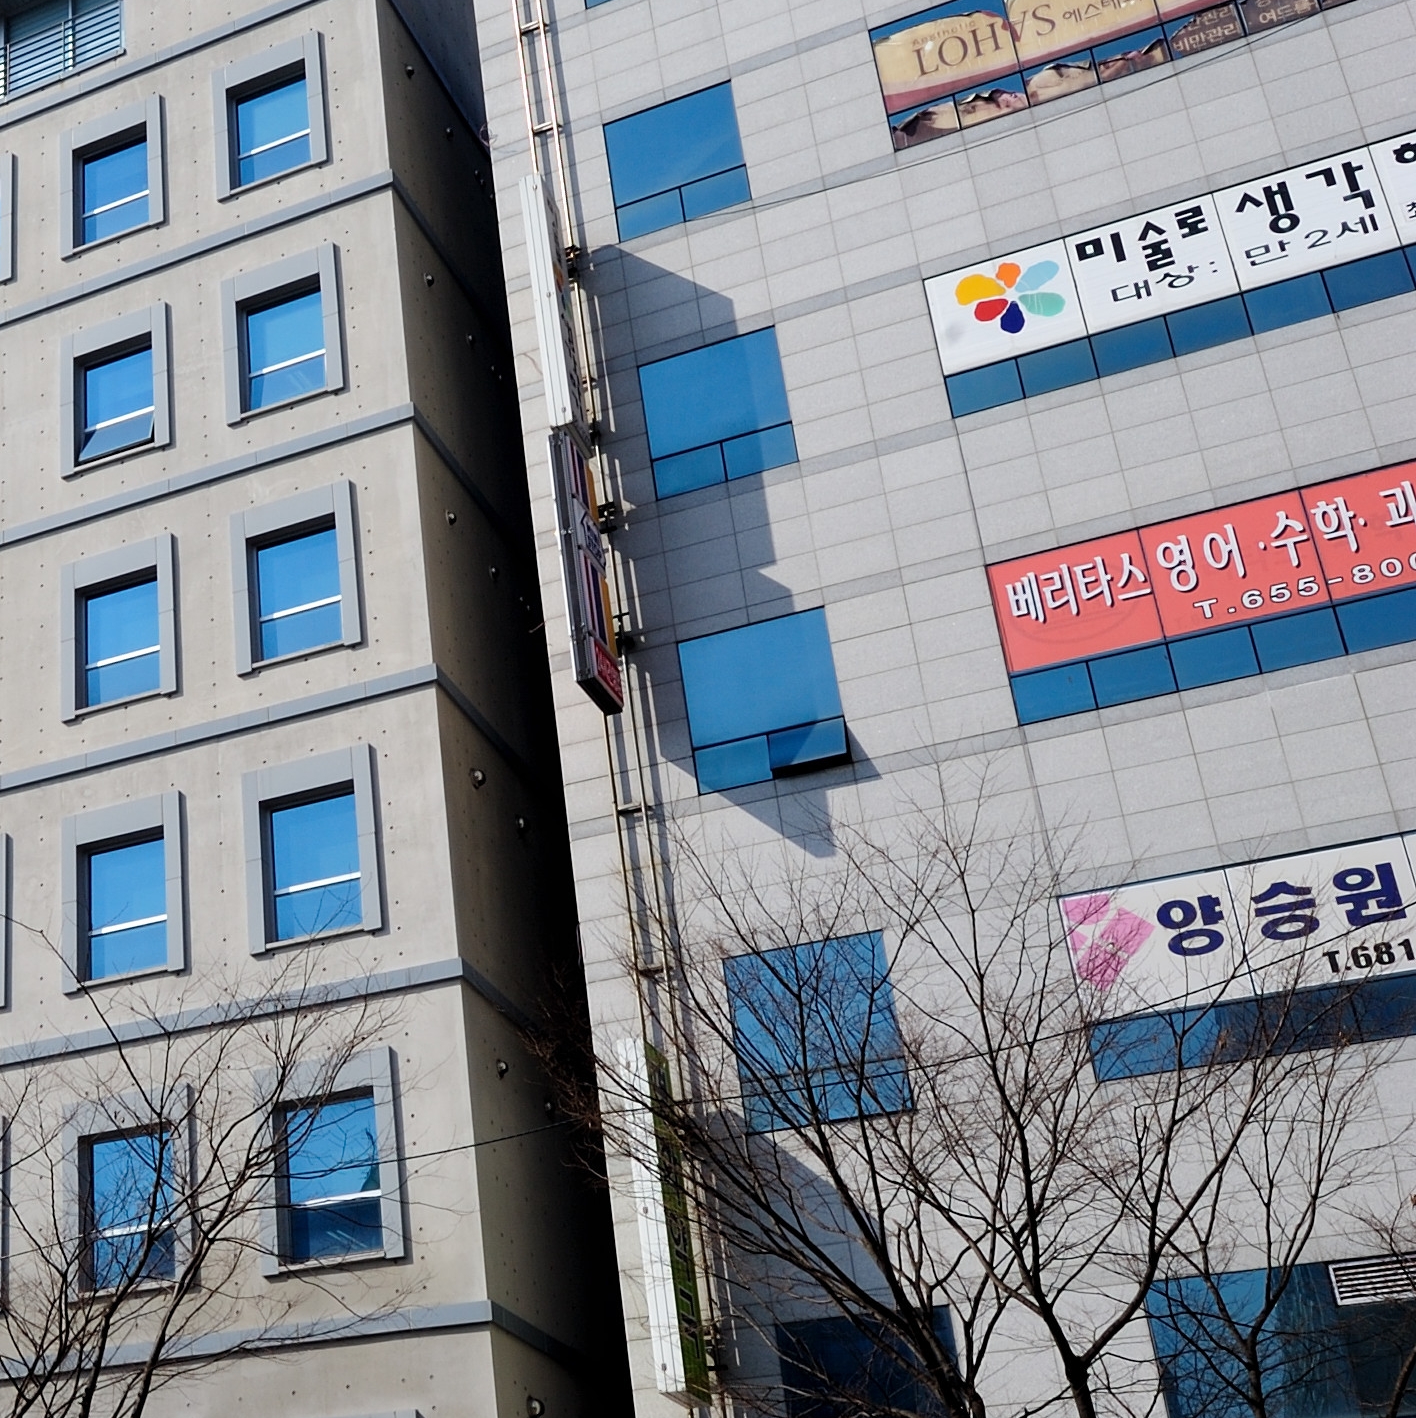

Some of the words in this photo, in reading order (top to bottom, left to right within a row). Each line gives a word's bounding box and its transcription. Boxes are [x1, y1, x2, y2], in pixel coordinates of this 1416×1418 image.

[1075, 204, 1209, 272] 미술로
[1245, 239, 1292, 266] 만
[1304, 213, 1380, 251] 2세
[1005, 552, 1152, 624] 베리타스
[1194, 550, 1416, 619] T.655-80
[1156, 862, 1407, 956] 양승원
